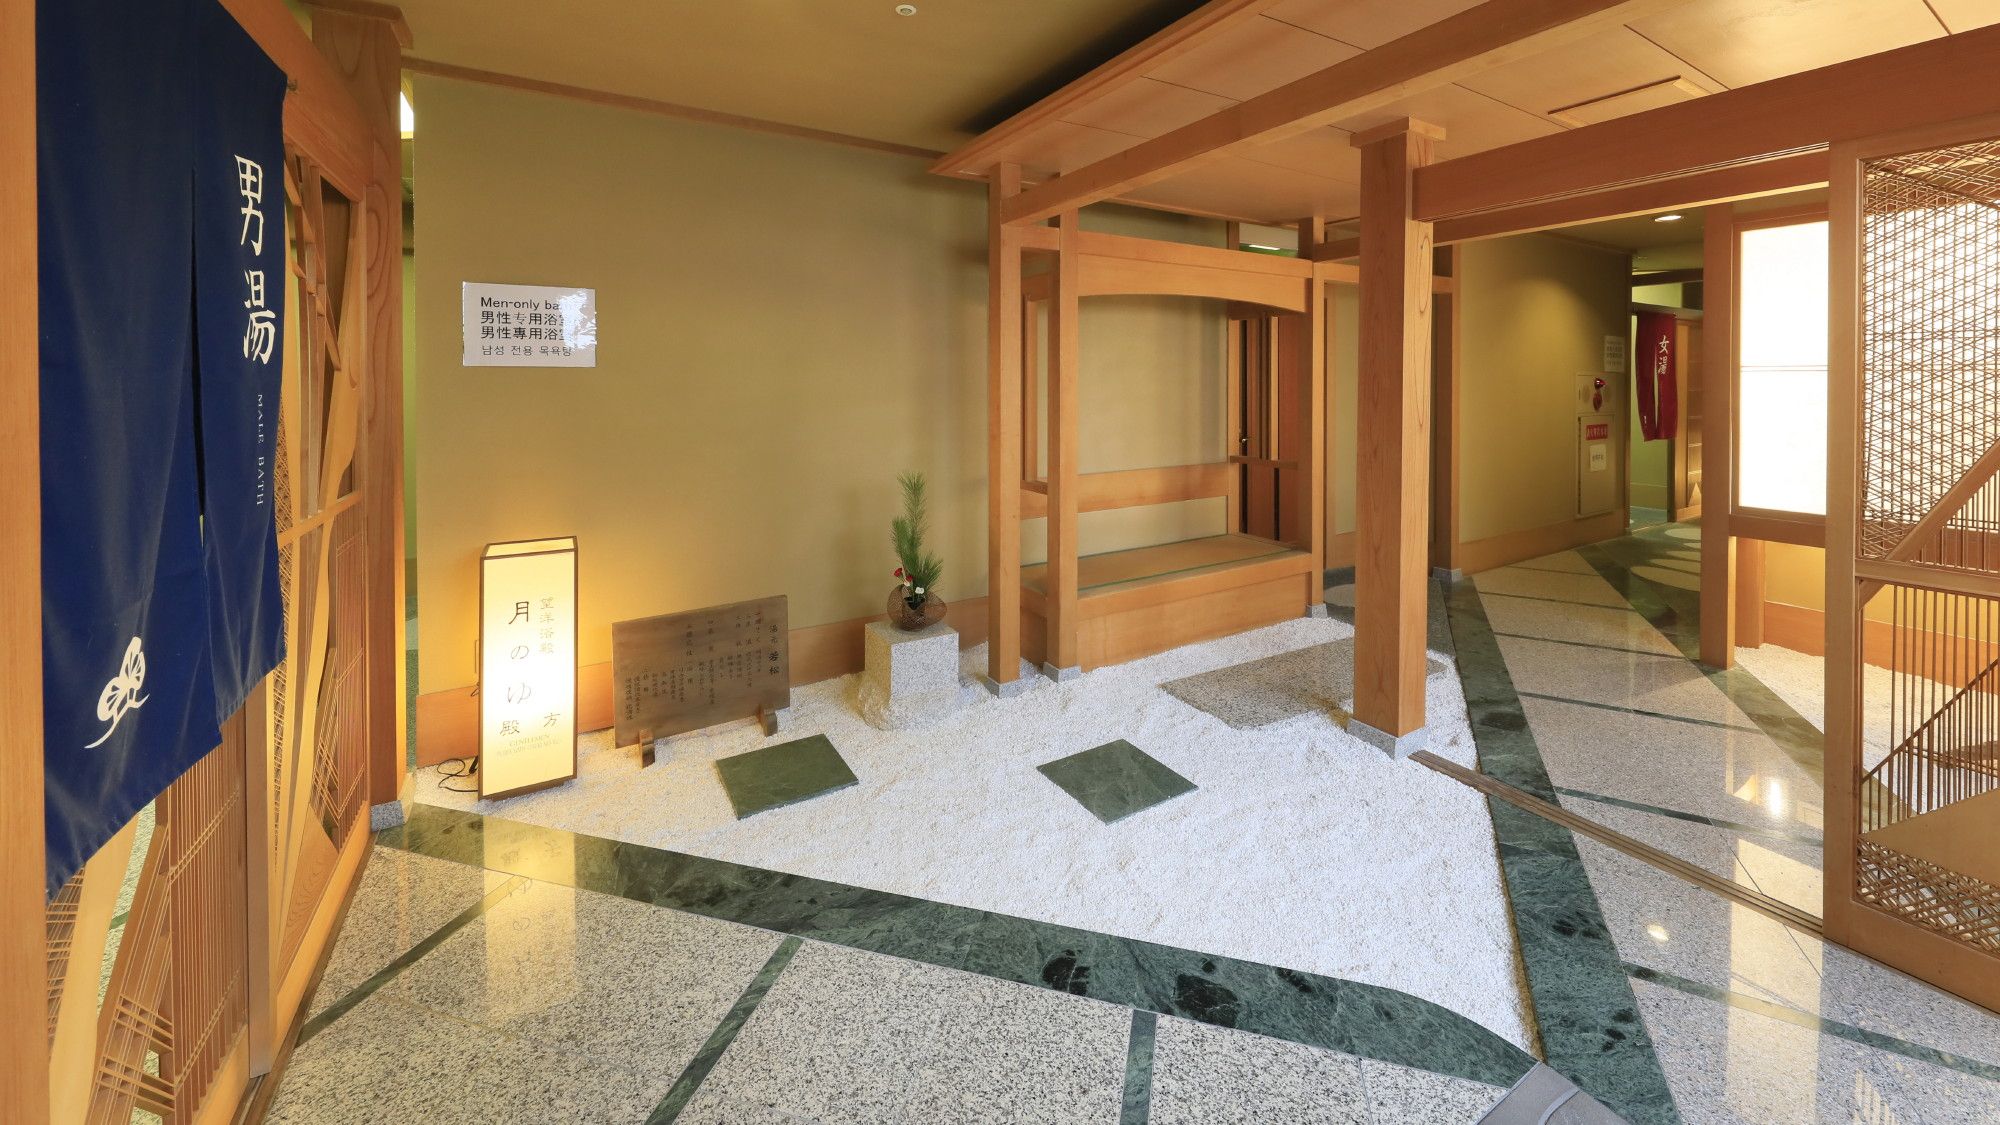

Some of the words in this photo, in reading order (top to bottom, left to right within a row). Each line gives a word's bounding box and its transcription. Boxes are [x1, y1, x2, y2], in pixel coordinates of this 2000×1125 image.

[234, 154, 276, 364] 男湯
[480, 297, 540, 311] Men-only
[482, 345, 505, 356] 남성
[511, 345, 533, 356] 전용
[1657, 334, 1670, 375] 女湯
[257, 456, 265, 505] BATH
[508, 601, 532, 705] 月のゆ
